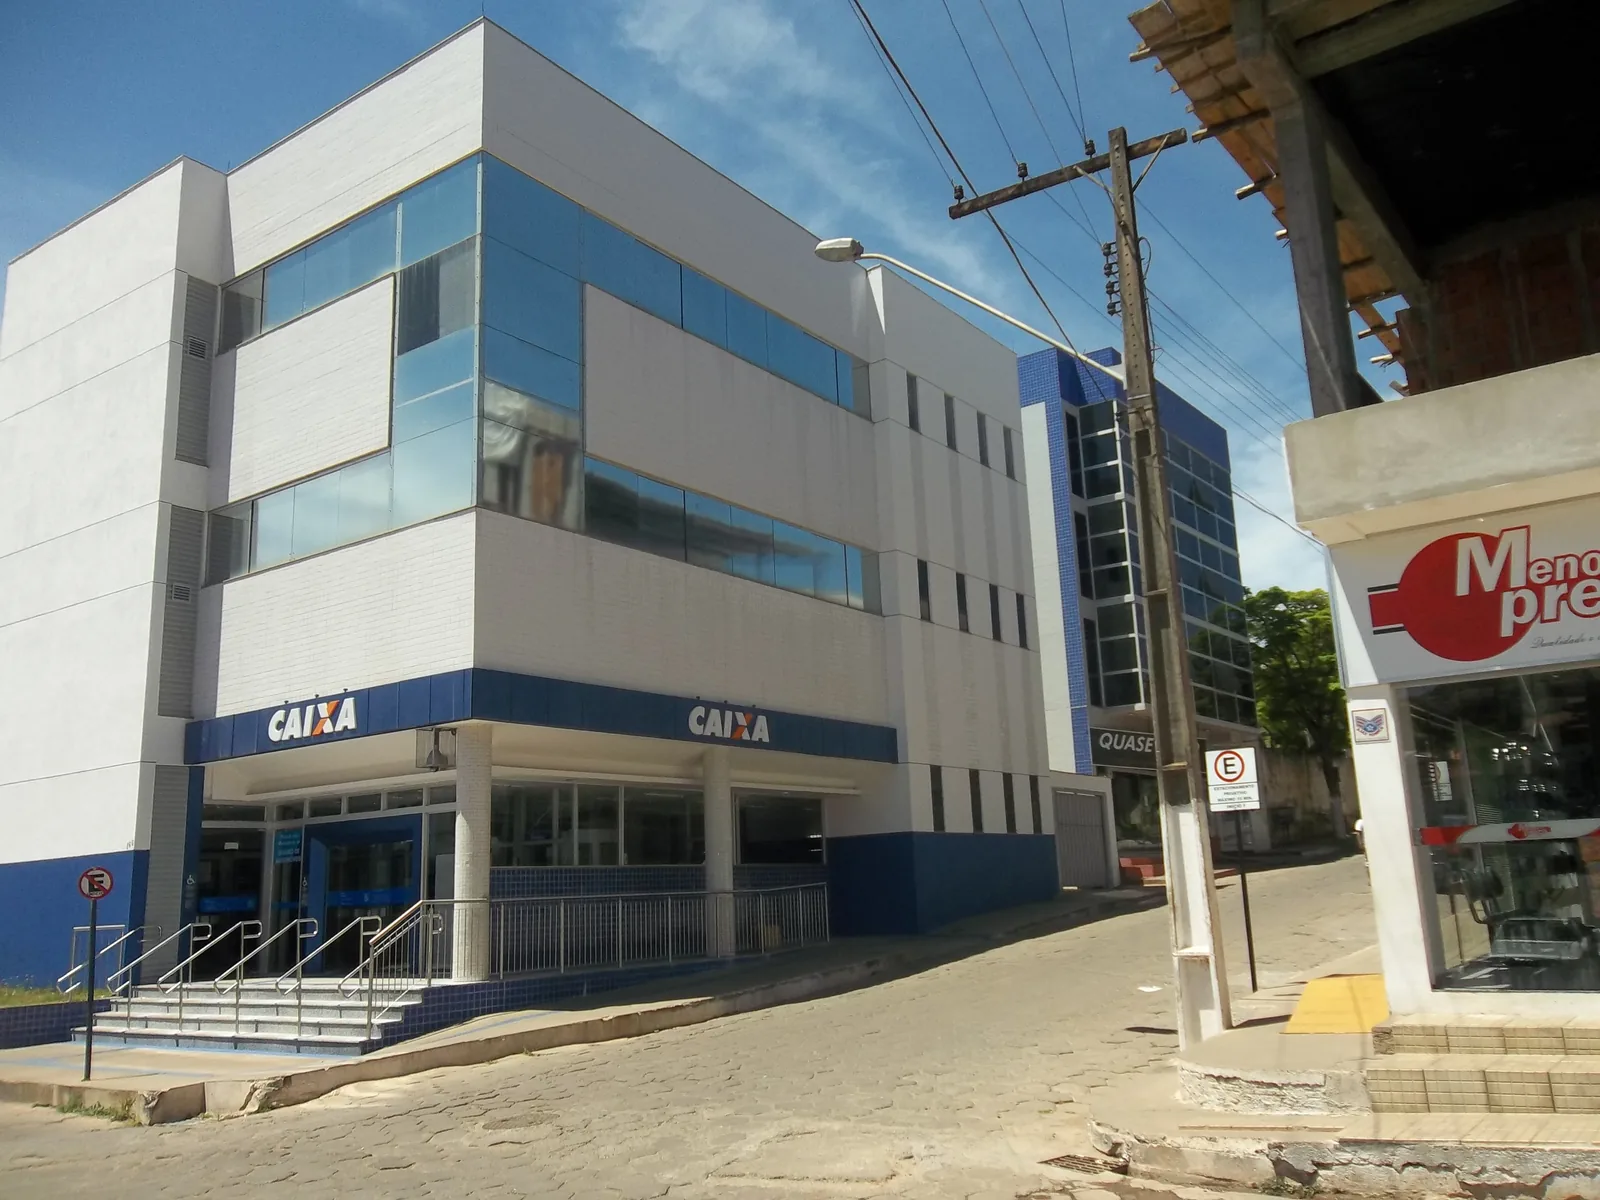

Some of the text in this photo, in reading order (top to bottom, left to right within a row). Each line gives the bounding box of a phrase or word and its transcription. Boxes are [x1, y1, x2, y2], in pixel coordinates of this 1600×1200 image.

[1501, 577, 1600, 638] pre
[268, 697, 357, 742] CAIXA
[688, 706, 770, 743] CAIXA
[1099, 732, 1155, 753] QUASE
[1223, 757, 1237, 774] E
